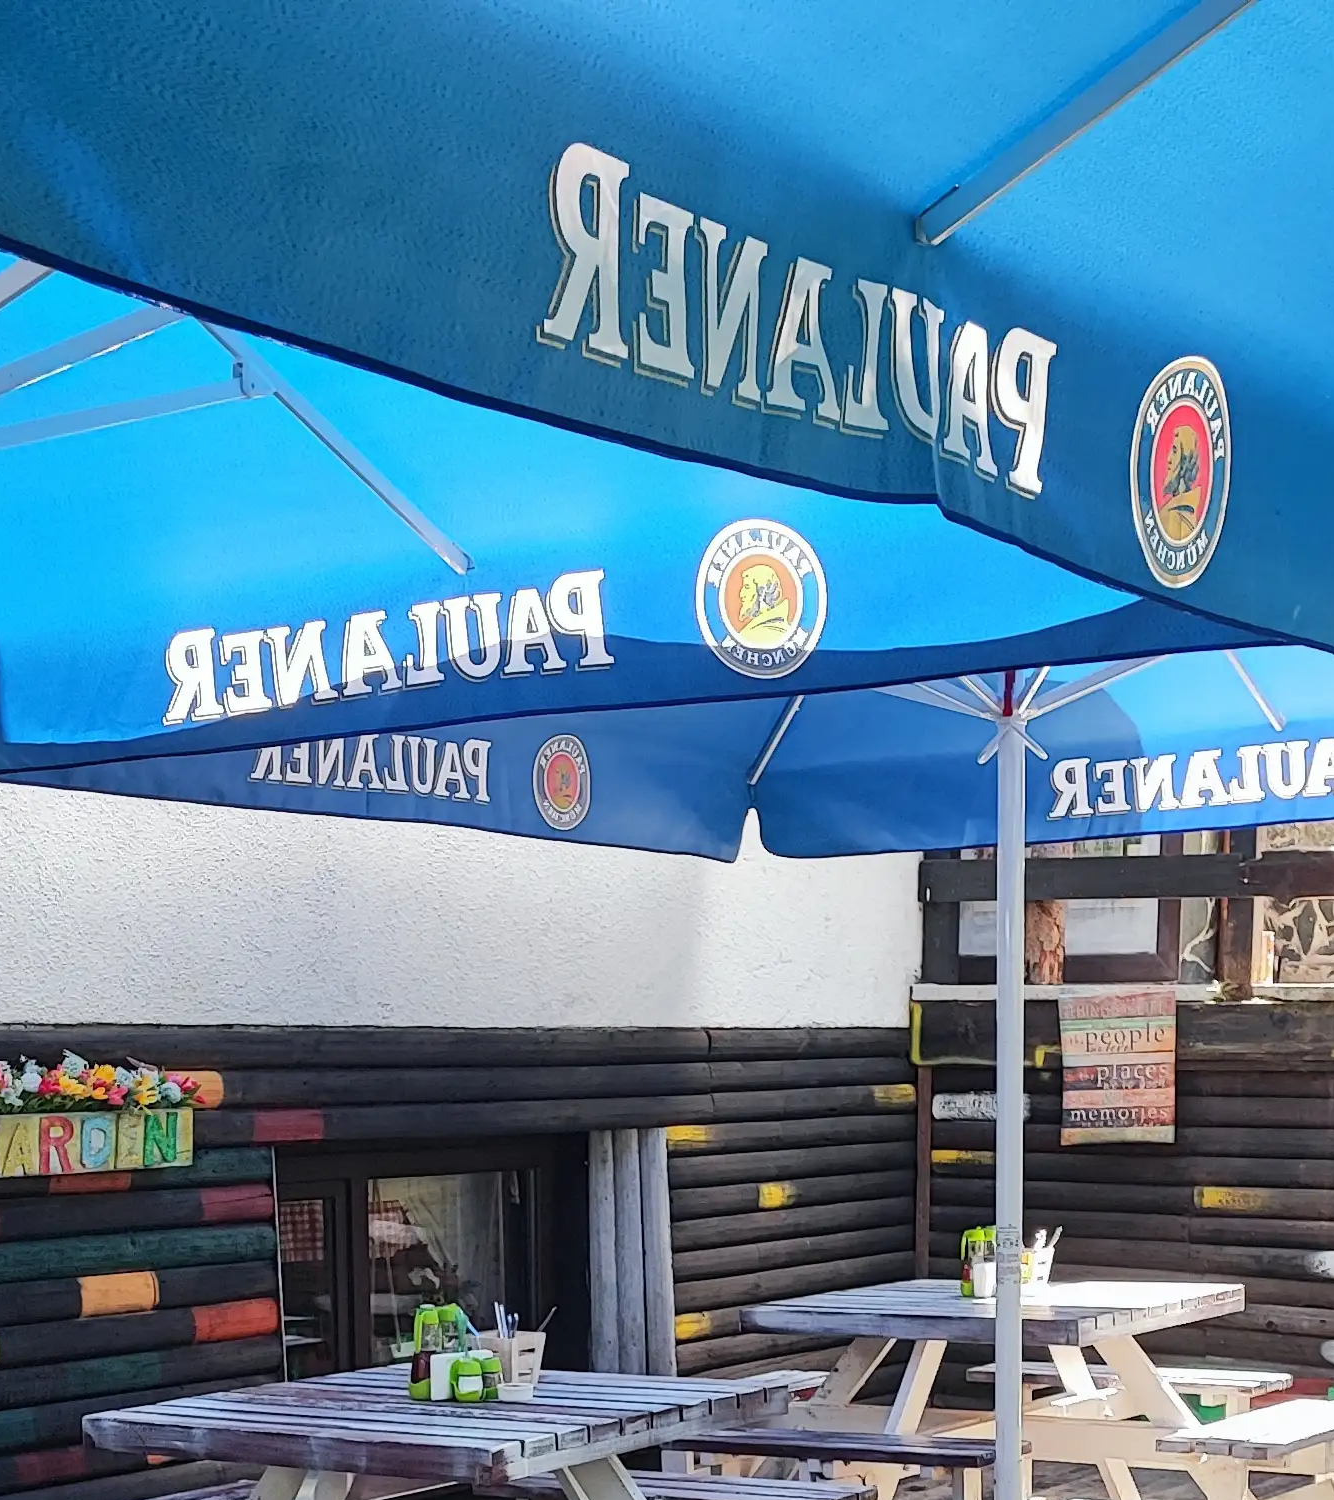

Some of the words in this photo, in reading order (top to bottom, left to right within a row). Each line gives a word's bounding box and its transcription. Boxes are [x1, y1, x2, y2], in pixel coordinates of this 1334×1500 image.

[1086, 1022, 1165, 1053] people
[1096, 1063, 1168, 1088] places
[1070, 1106, 1170, 1127] memories
